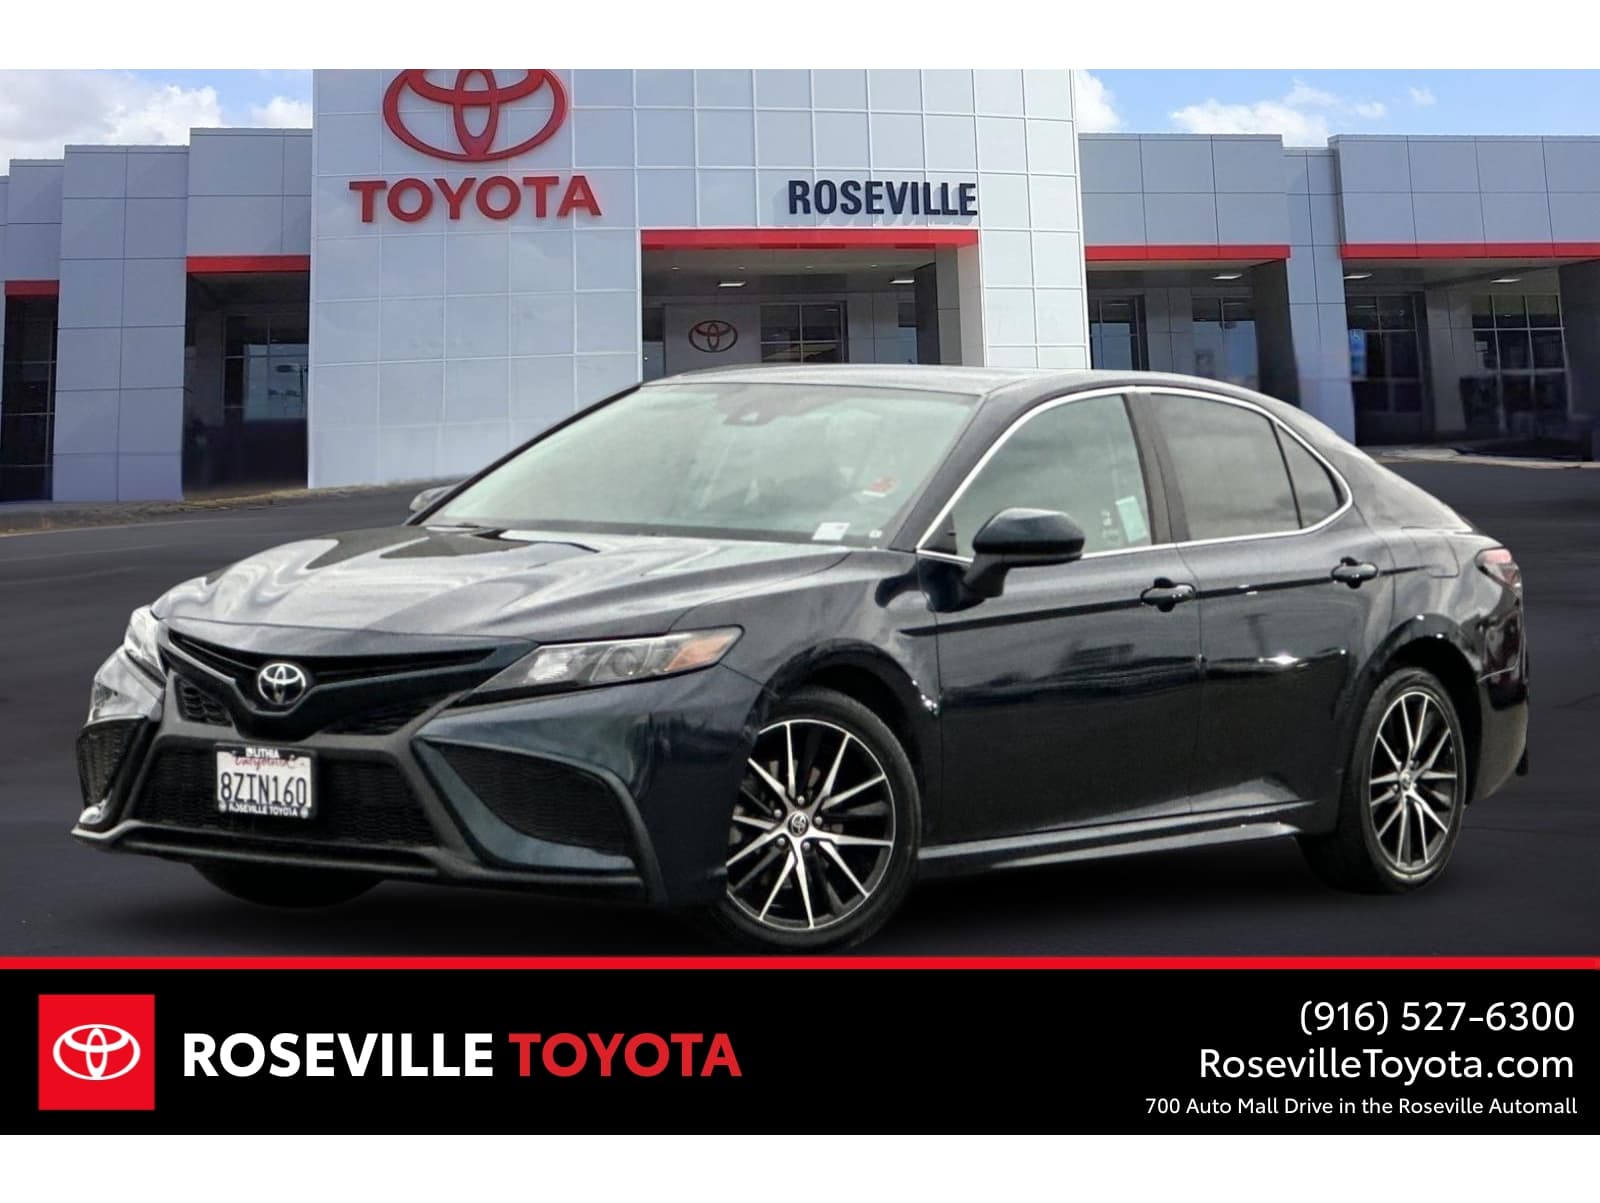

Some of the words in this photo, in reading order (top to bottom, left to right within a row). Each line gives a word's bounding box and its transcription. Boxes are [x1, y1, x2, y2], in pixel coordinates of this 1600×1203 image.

[349, 175, 602, 223] TOYOTA
[788, 180, 978, 216] ROSEVILLE
[220, 771, 307, 807] 8ZIN160
[228, 803, 268, 815] ROSEVILLE
[269, 806, 298, 817] TOYOTA
